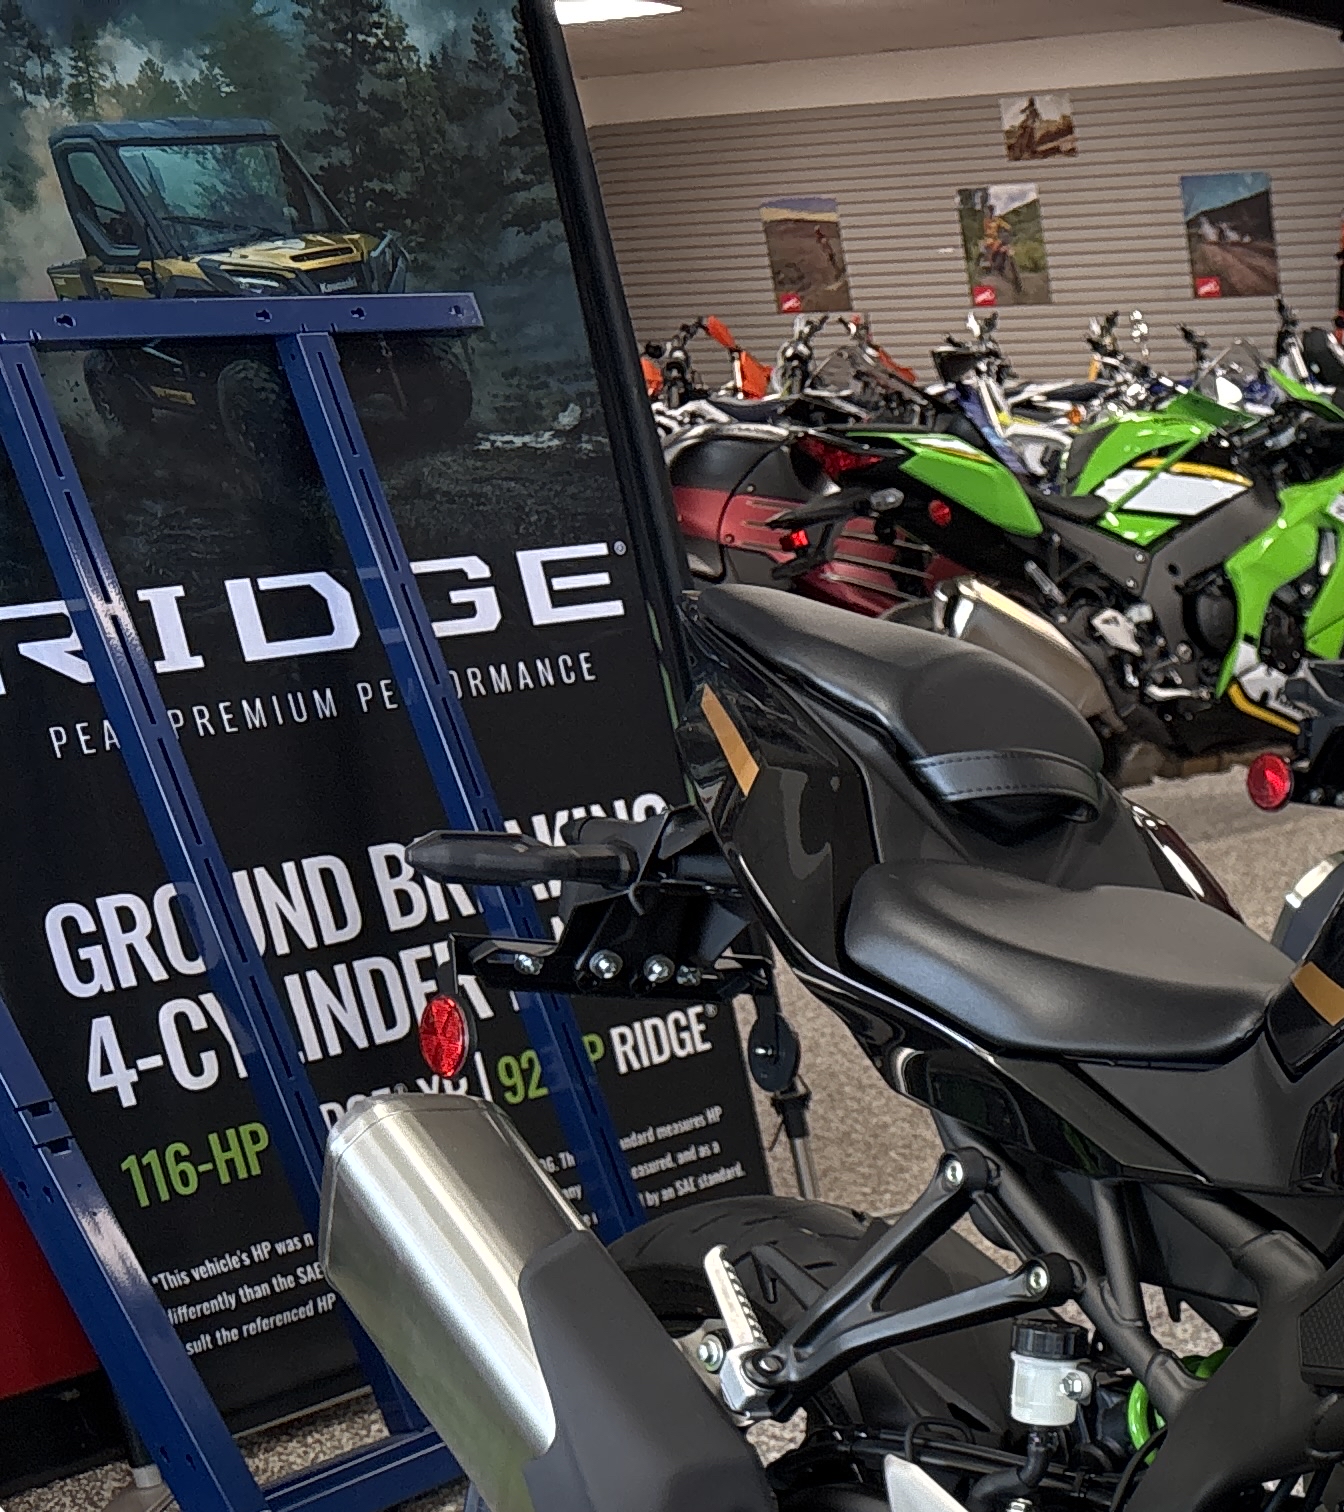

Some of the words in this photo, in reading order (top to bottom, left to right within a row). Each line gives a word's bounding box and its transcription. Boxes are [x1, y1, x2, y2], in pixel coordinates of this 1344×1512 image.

[49, 719, 121, 759] PEA
[169, 688, 339, 741] PREMIUM
[120, 1122, 271, 1208] 116-HP
[190, 1249, 251, 1282] vehicle's
[249, 1240, 272, 1264] HP
[274, 1236, 302, 1257] was
[655, 1112, 706, 1140] measures
[704, 1105, 723, 1124] HP
[238, 1281, 272, 1304] than
[271, 1271, 296, 1293] the
[295, 1260, 326, 1286] SAE
[630, 1151, 677, 1180] easured,
[676, 1144, 698, 1165] and
[215, 1325, 240, 1347] the
[241, 1300, 315, 1339] referenced
[316, 1291, 337, 1316] HP
[674, 1175, 697, 1197] SAE
